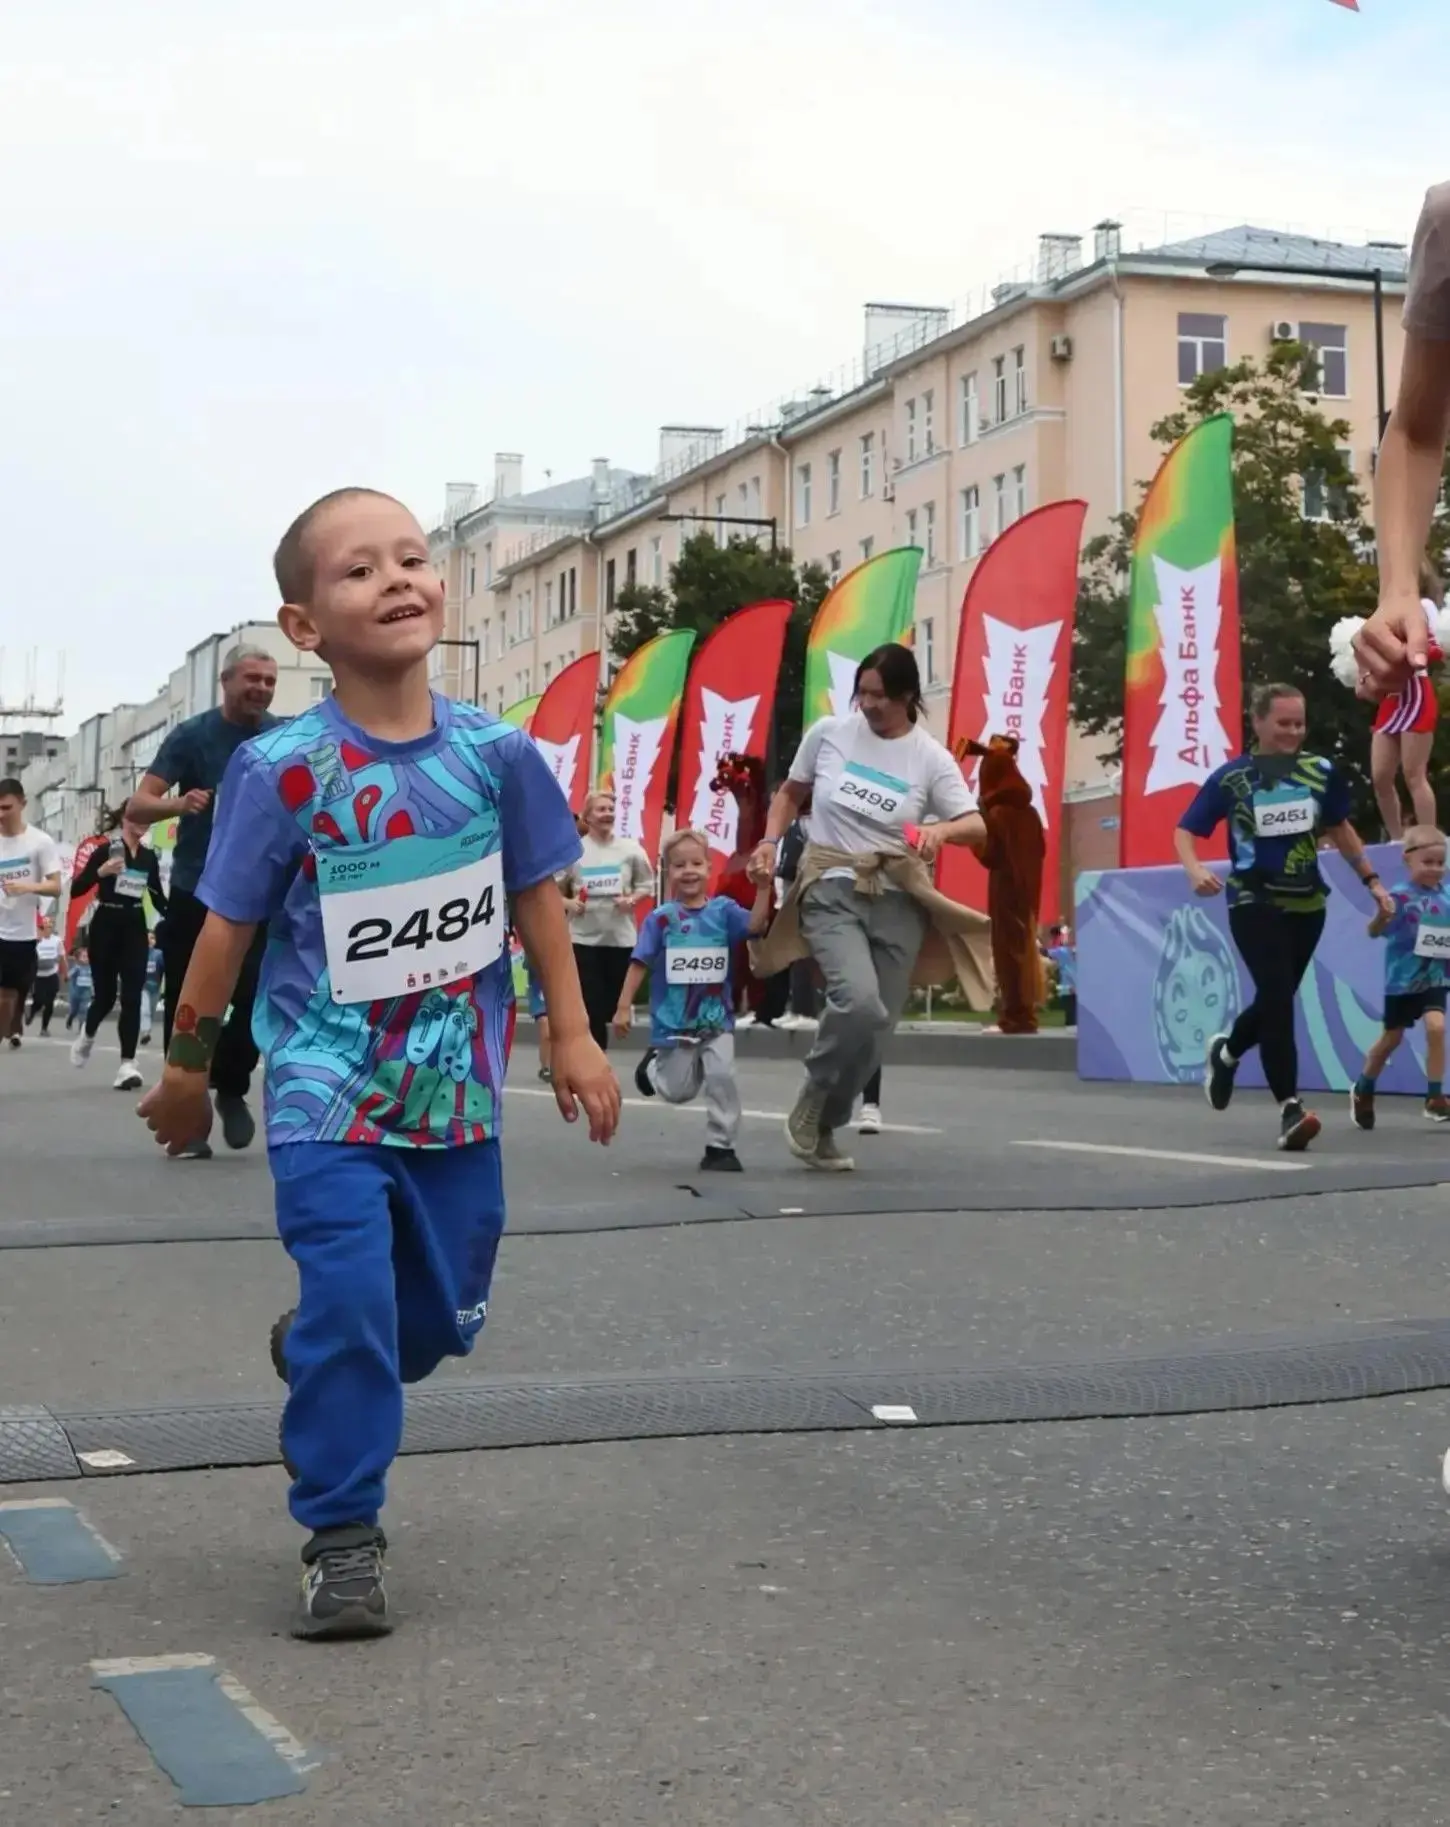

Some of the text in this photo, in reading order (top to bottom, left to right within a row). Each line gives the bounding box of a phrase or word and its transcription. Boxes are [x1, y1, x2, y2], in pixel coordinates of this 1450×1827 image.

[1003, 643, 1028, 707] Банк
[1178, 585, 1205, 767] Альфа Банк
[620, 732, 642, 780] Банк
[704, 787, 728, 838] Аль
[840, 781, 897, 812] 2498
[1262, 808, 1308, 826] 2451
[329, 861, 366, 875] 1000
[345, 885, 495, 962] 2484
[671, 956, 726, 971] 2498
